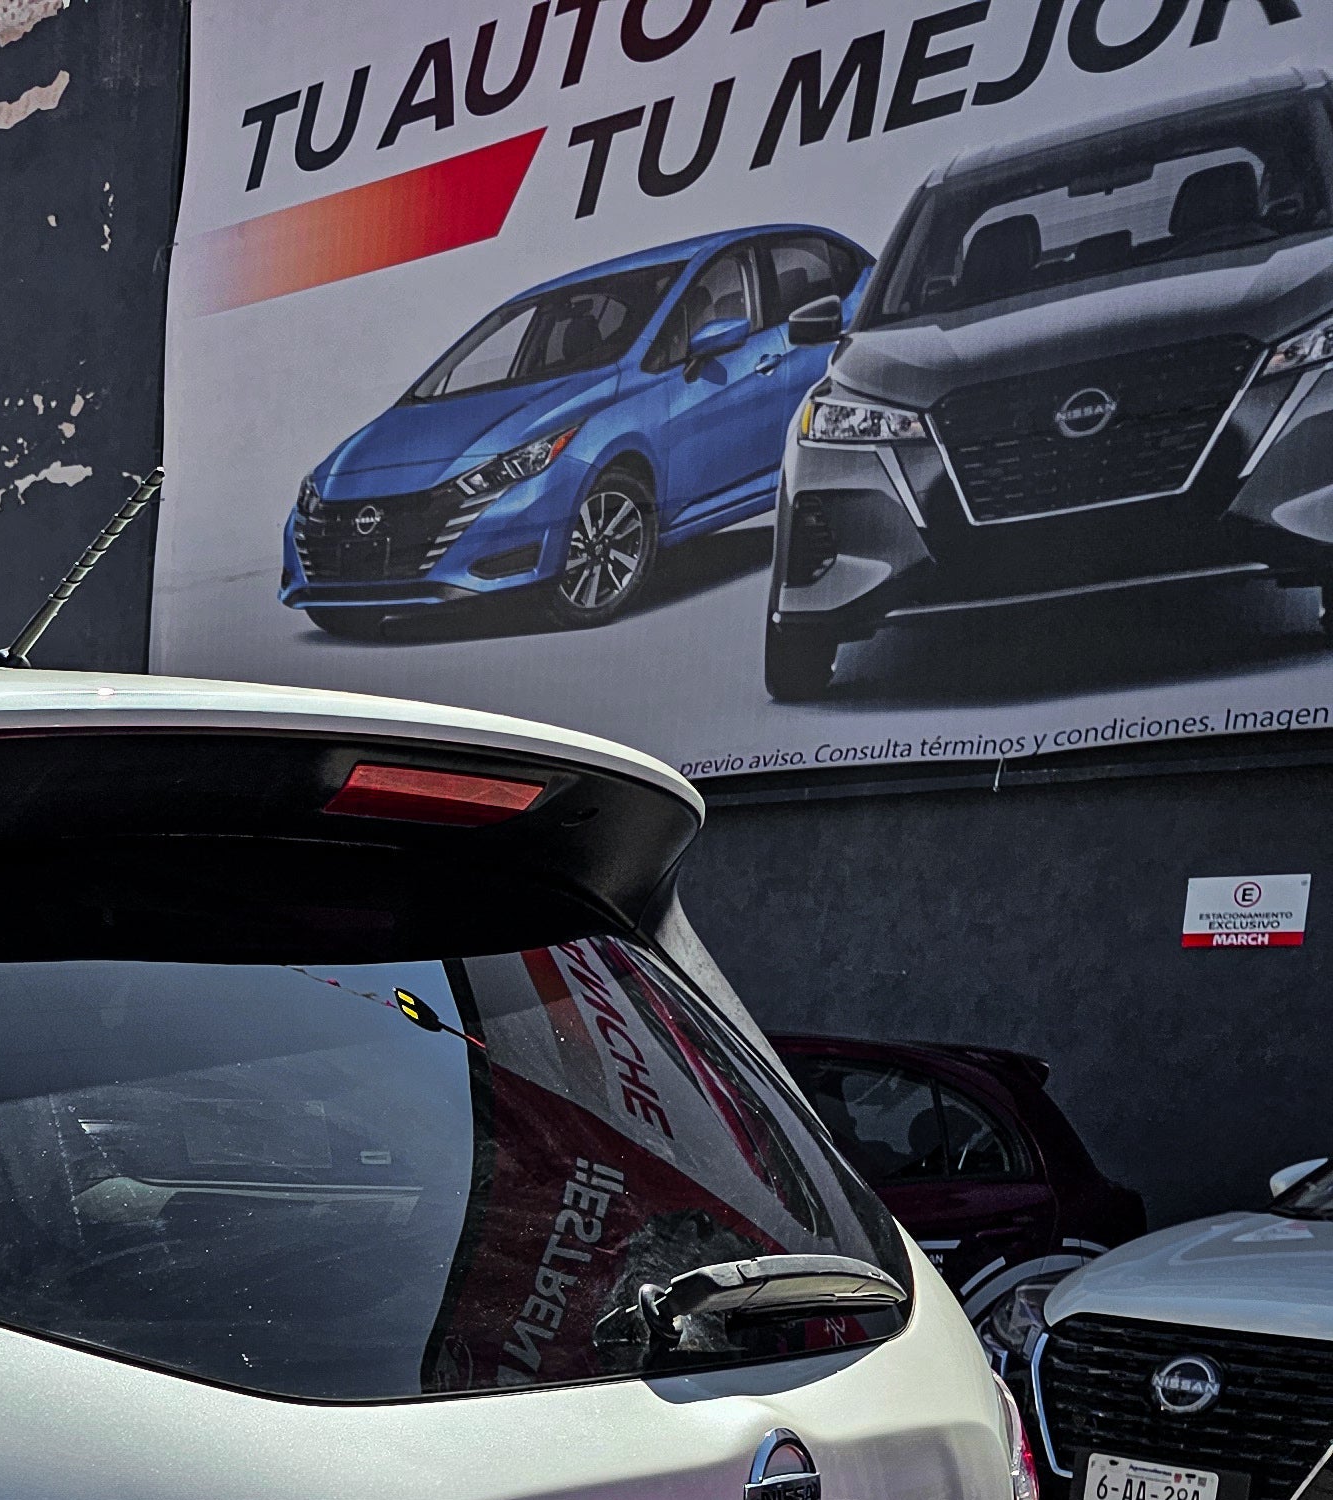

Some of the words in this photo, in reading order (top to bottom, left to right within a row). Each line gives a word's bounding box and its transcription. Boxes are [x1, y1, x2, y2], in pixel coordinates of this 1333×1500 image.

[241, 64, 372, 193] TU
[376, 0, 712, 152] AUTO
[567, 76, 736, 221] TU
[680, 754, 744, 778] previo
[749, 748, 806, 769] aviso.
[814, 738, 912, 764] Consulta
[919, 734, 1026, 757] términos
[1034, 733, 1047, 754] y
[1053, 716, 1216, 748] condiciones.
[1224, 706, 1329, 731] Imagen
[1199, 911, 1293, 921] ESTACIONAMIENTO
[1208, 919, 1281, 931] EXCLUSIVO
[1212, 933, 1270, 947] MARCH
[1152, 1373, 1221, 1396] NISSAN
